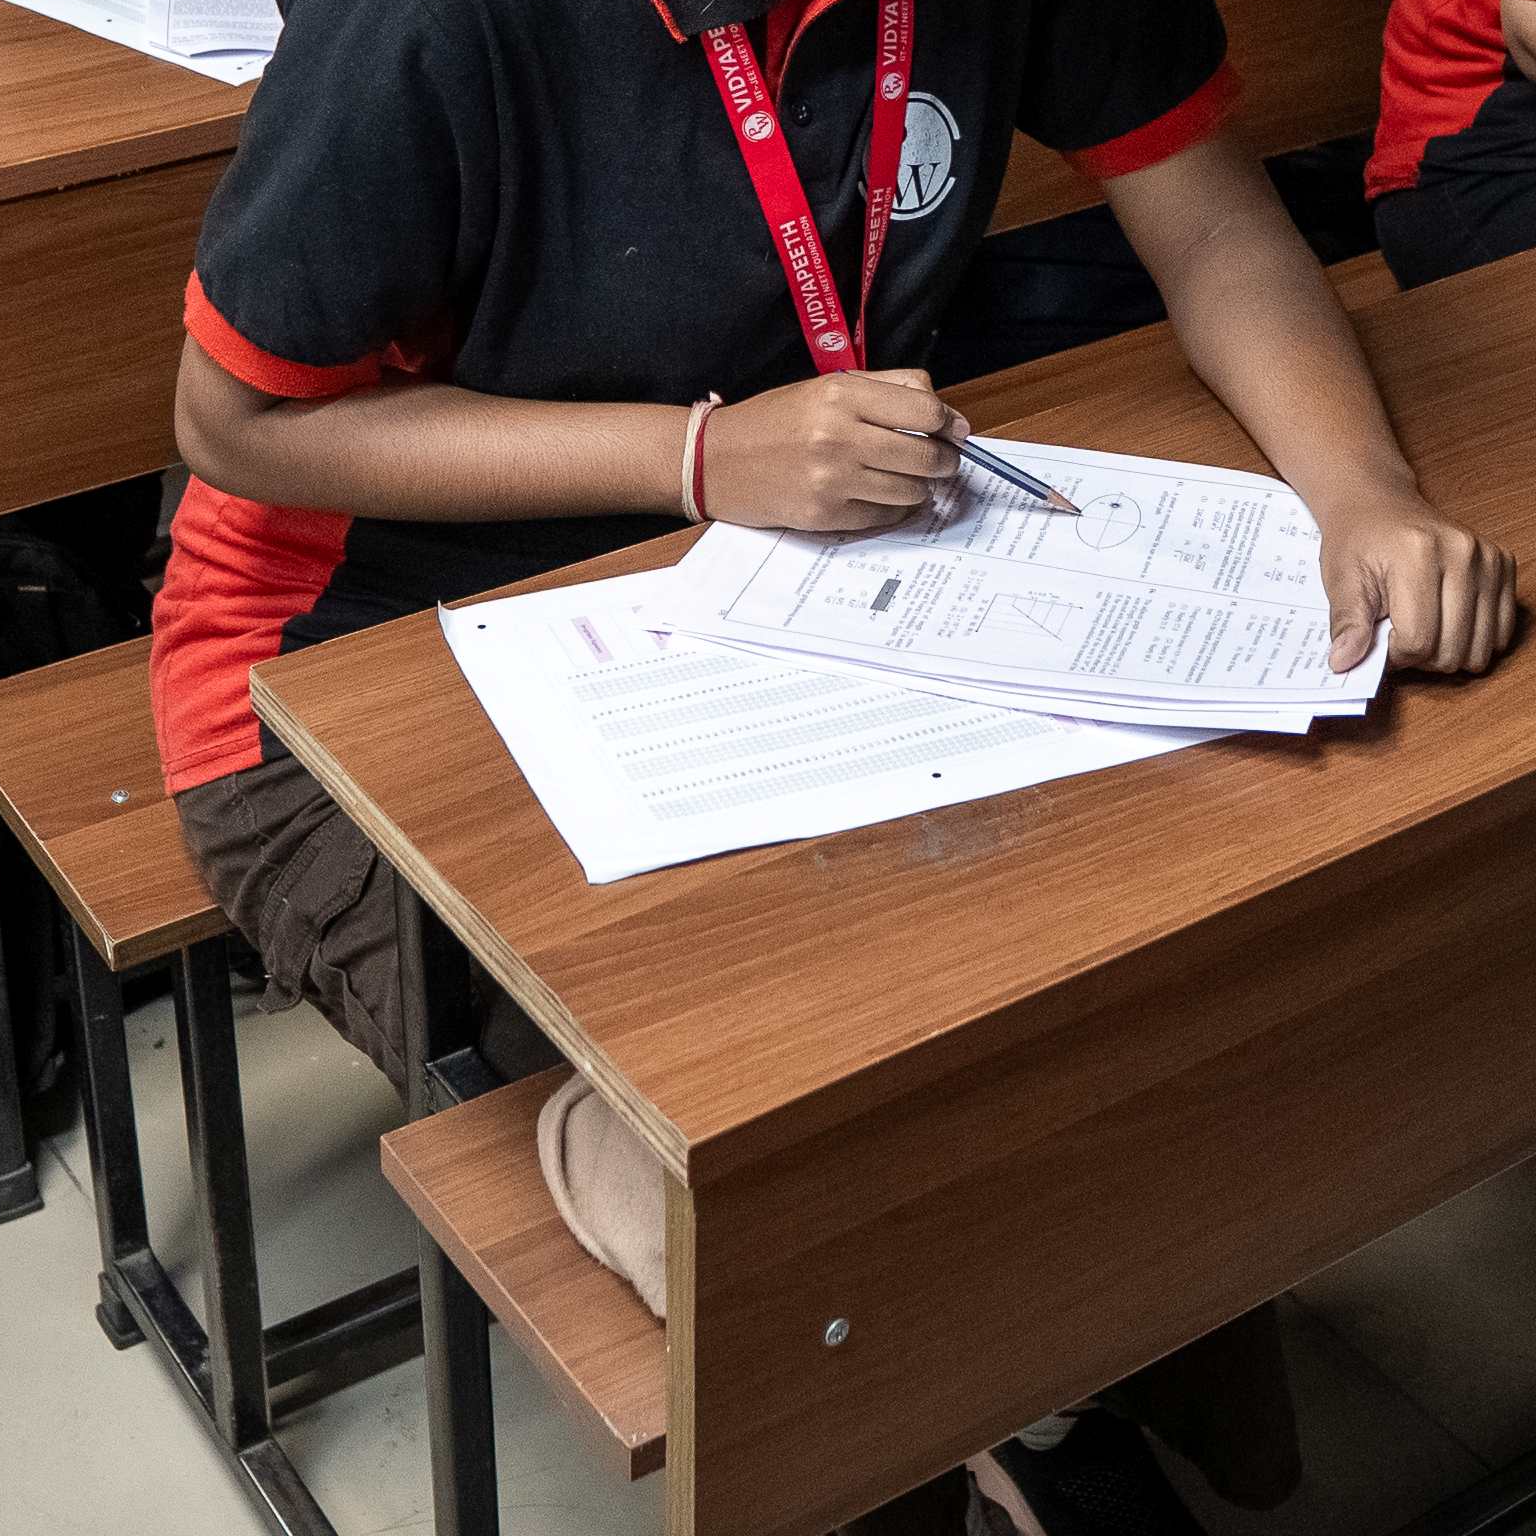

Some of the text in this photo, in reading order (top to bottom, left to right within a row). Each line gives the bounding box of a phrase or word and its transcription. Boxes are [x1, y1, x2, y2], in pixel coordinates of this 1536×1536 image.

[707, 25, 753, 114] VIDYAPE
[779, 220, 828, 330] VIDYAPEETH
[799, 215, 822, 269] FOUNDATION
